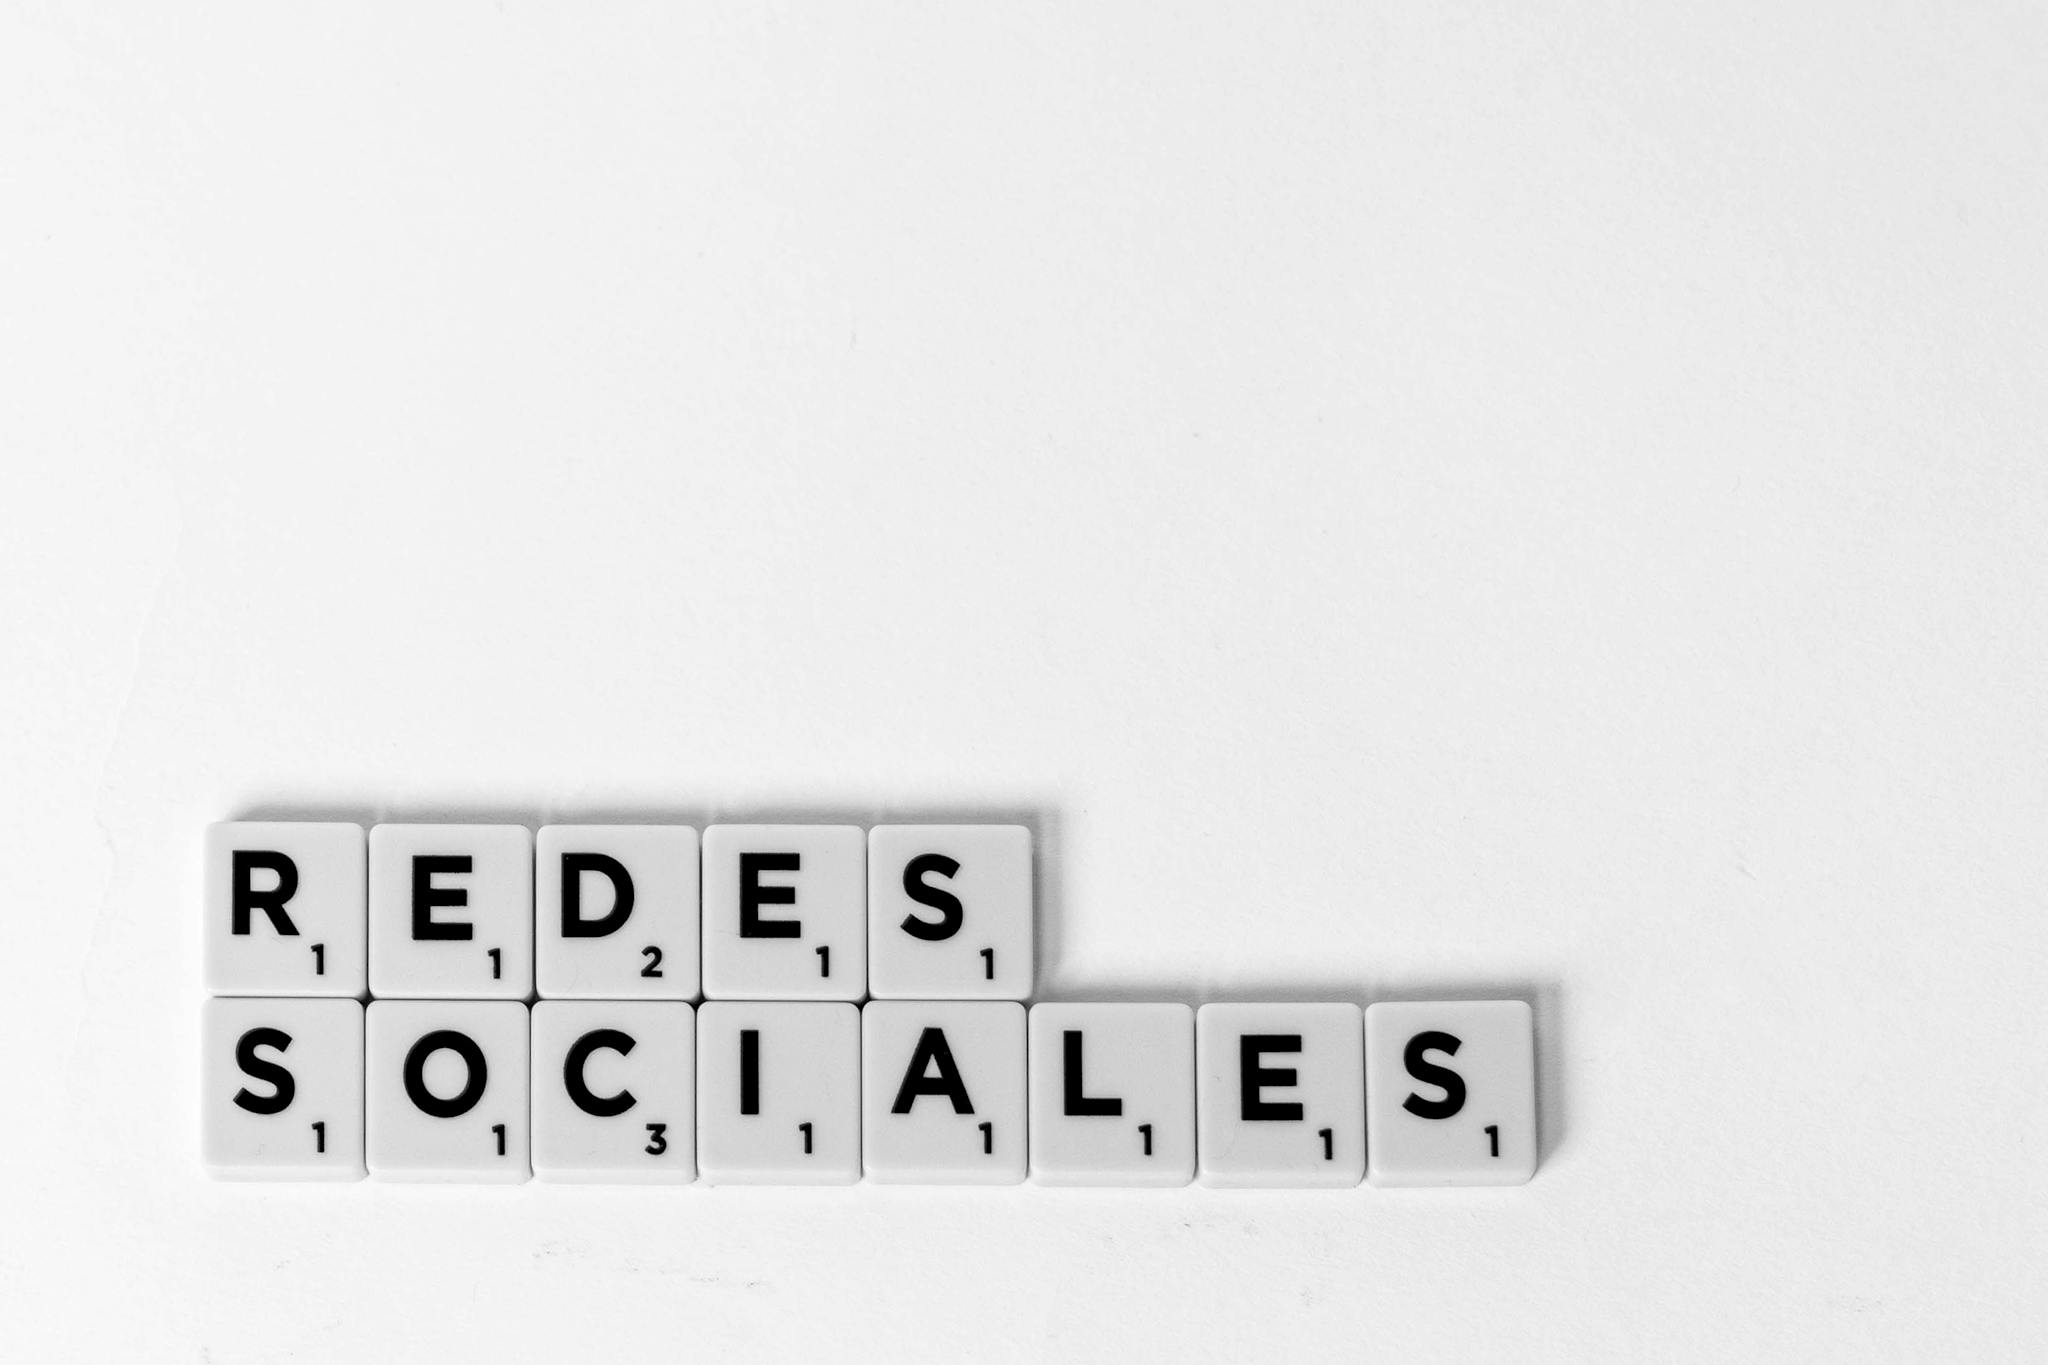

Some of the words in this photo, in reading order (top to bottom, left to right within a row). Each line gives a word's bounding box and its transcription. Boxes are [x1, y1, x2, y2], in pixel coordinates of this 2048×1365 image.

[231, 850, 964, 941] REDES
[310, 943, 325, 976] 1
[487, 947, 501, 980] 1
[640, 945, 663, 978] 2
[815, 945, 830, 978] 1
[979, 947, 994, 980] 1
[232, 1027, 1467, 1121] SOCIALES
[311, 1121, 325, 1153] 1
[491, 1123, 506, 1156] 1
[644, 1123, 667, 1156] 3
[798, 1122, 813, 1155] 1
[978, 1121, 993, 1155] 1
[1138, 1123, 1153, 1156] 1
[1318, 1128, 1333, 1161] 1
[1484, 1124, 1499, 1158] 1
